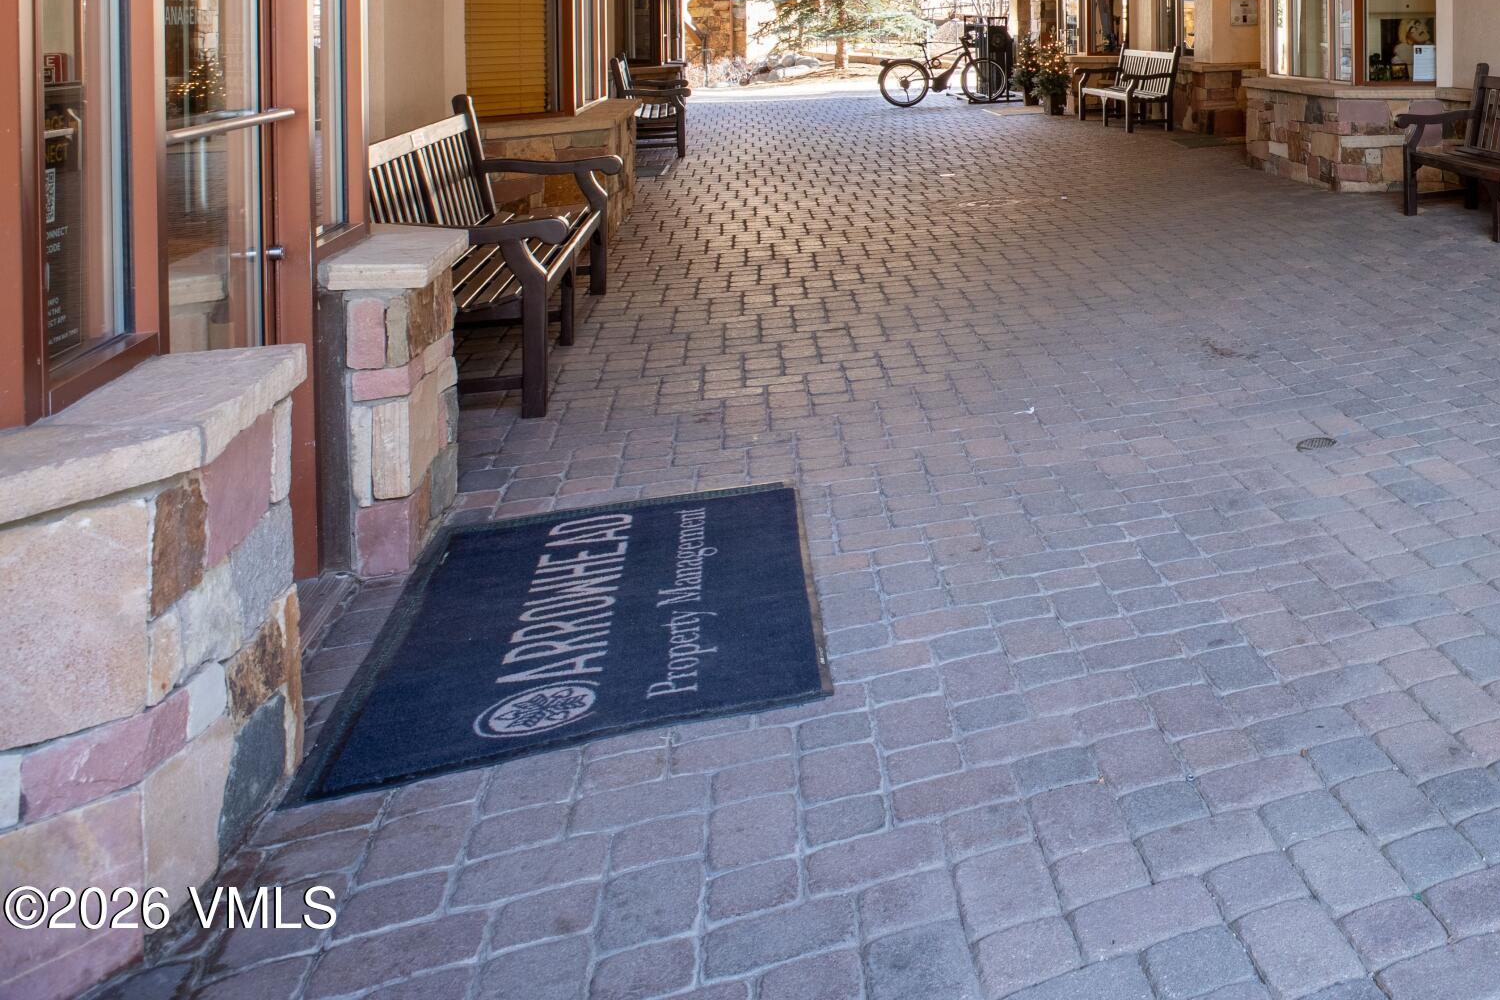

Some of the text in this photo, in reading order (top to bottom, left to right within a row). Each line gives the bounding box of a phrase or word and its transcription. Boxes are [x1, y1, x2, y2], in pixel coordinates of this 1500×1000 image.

[495, 513, 633, 684] ARROWHEAD
[646, 507, 718, 700] Property Management
